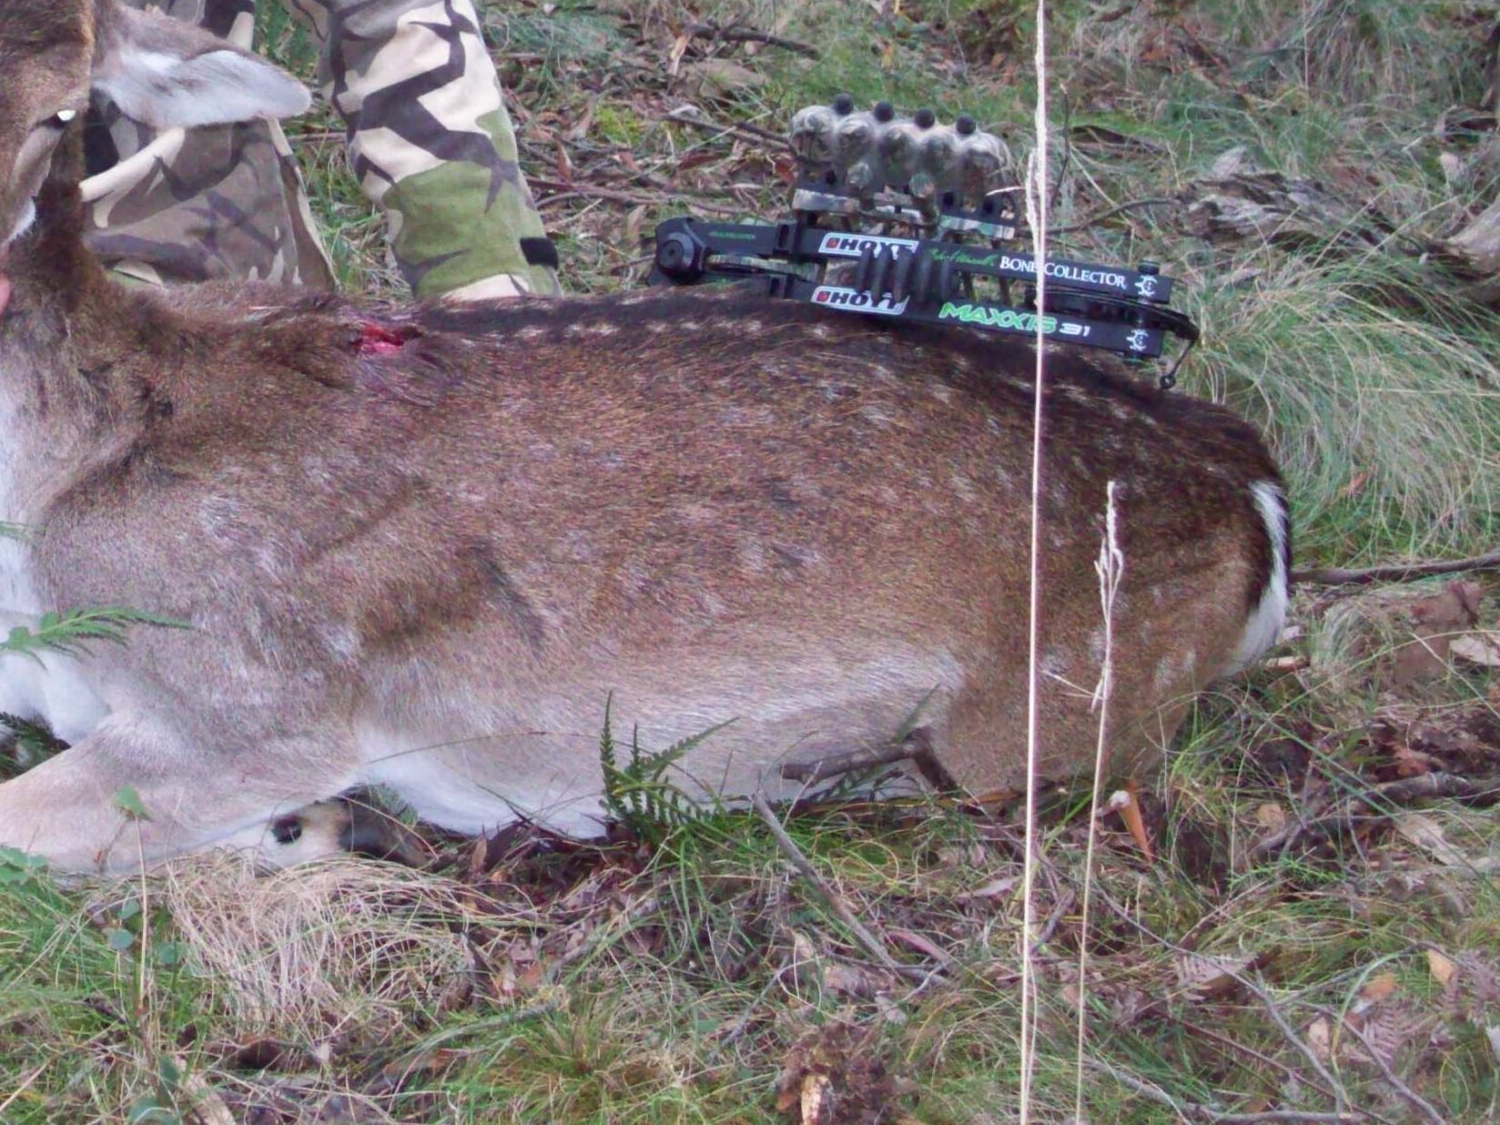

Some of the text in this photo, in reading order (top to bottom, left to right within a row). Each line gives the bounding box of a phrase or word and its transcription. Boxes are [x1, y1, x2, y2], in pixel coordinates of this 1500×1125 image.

[1044, 262, 1127, 290] COLLECTOR
[938, 302, 1091, 337] MAXXIS 31
